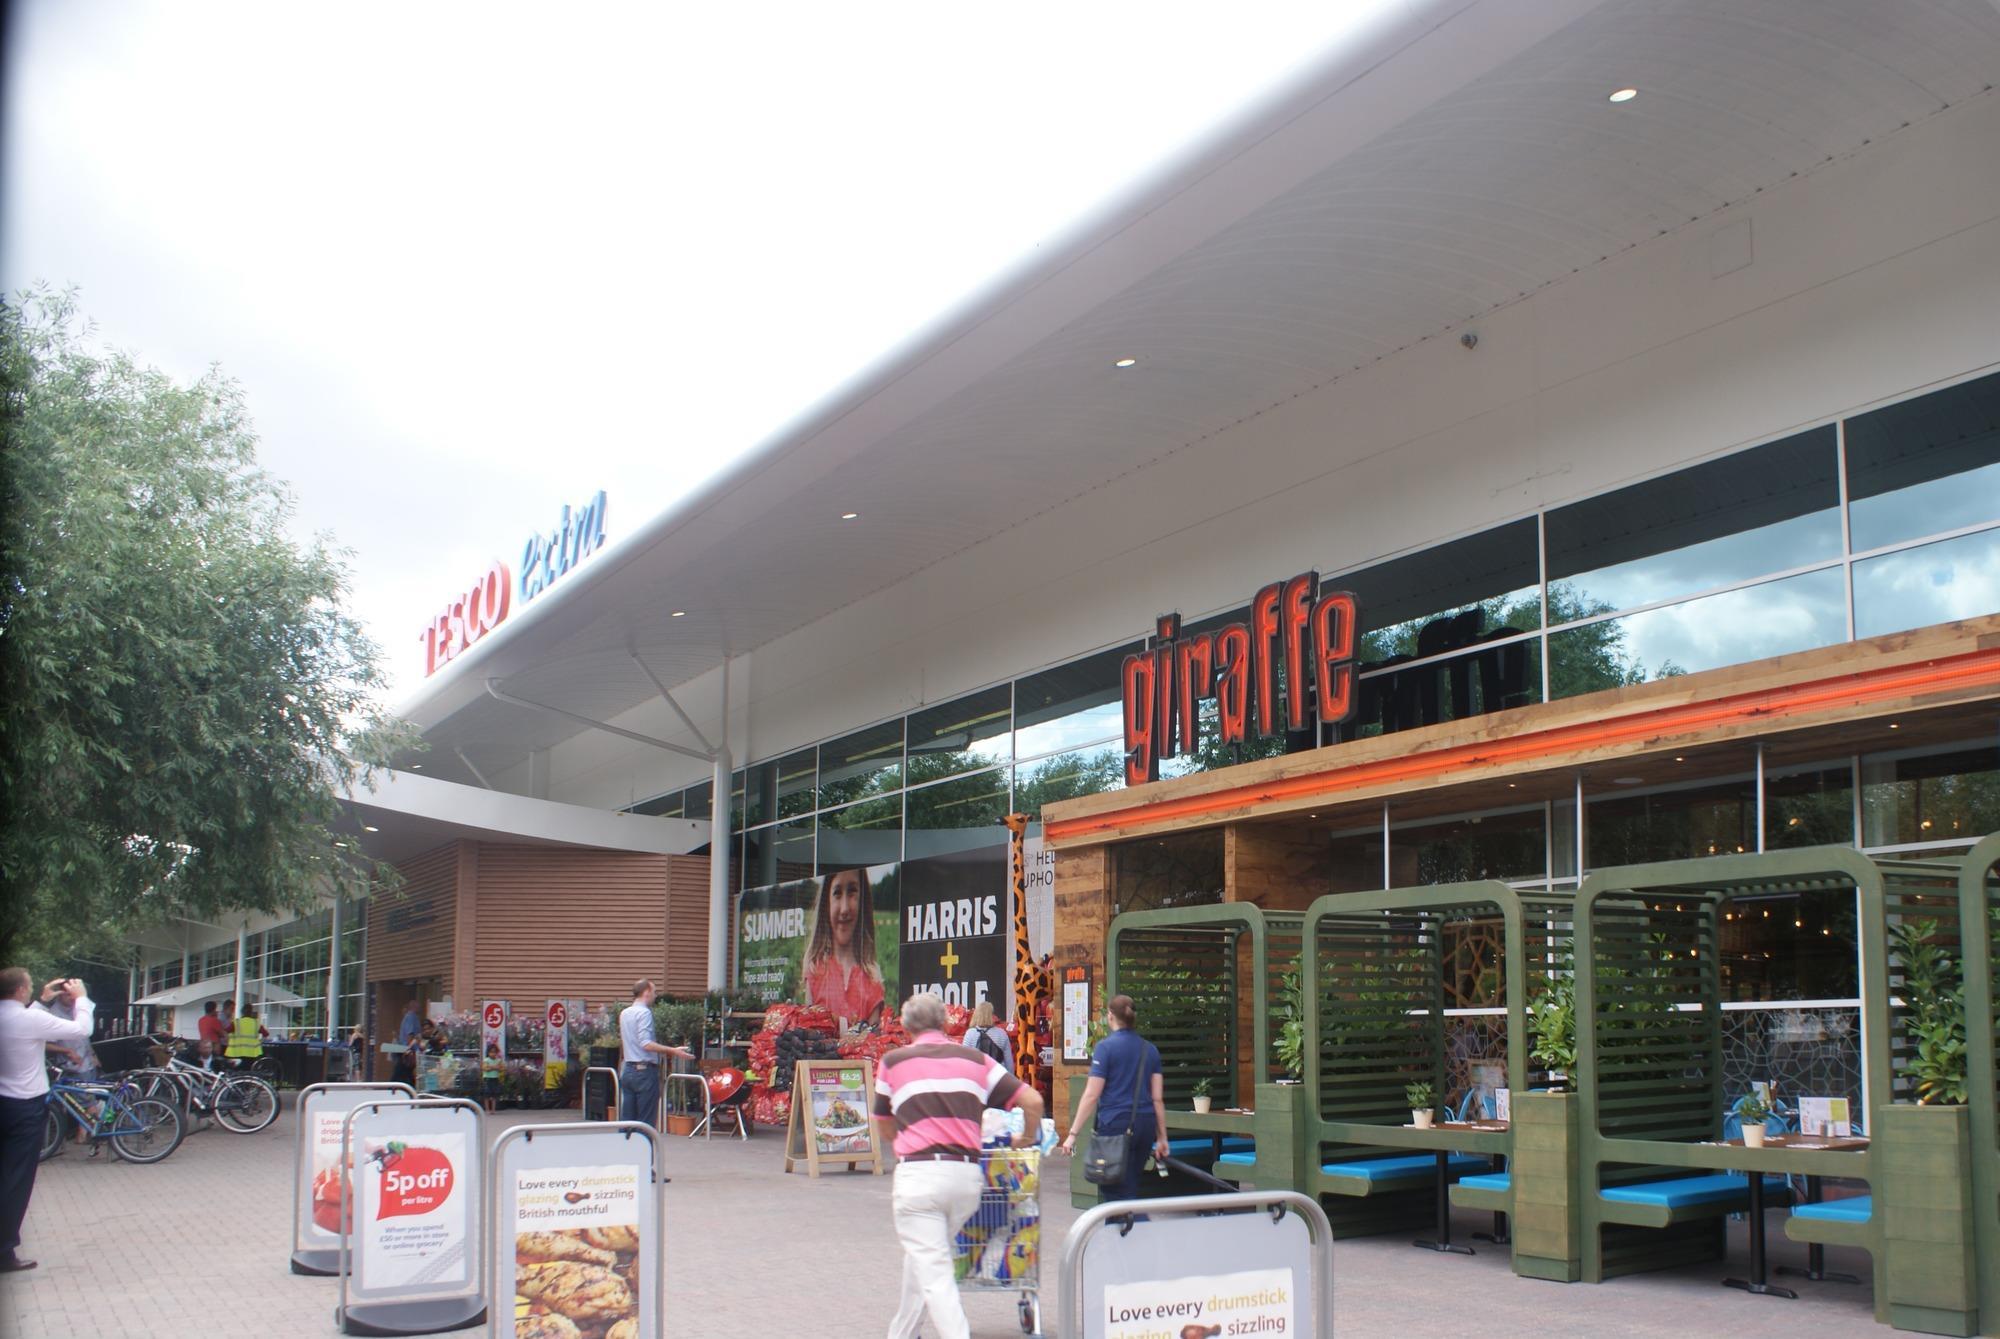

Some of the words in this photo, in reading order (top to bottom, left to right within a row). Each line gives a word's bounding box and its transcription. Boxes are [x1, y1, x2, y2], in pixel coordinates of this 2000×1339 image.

[420, 559, 511, 678] TESCO
[519, 488, 609, 606] extra
[1122, 571, 1360, 787] giraffe
[744, 908, 807, 943] SUMMER
[907, 895, 998, 942] HARRIS
[487, 1007, 502, 1025] £5
[551, 1007, 564, 1024] £5
[812, 1071, 839, 1080] LUNCH
[385, 1170, 415, 1195] 5p
[417, 1168, 449, 1188] off
[519, 1180, 546, 1190] Love
[548, 1178, 579, 1189] every
[581, 1174, 635, 1187] drumstick
[402, 1197, 415, 1206] per
[416, 1196, 433, 1204] litre
[518, 1194, 559, 1207] glazing
[594, 1190, 634, 1200] sizzling
[519, 1207, 555, 1219] British
[557, 1204, 608, 1217] mouthful
[1110, 1305, 1152, 1324] Love
[1156, 1301, 1203, 1320] every
[1207, 1287, 1287, 1313] drumstick
[1227, 1315, 1286, 1336] sizzling
